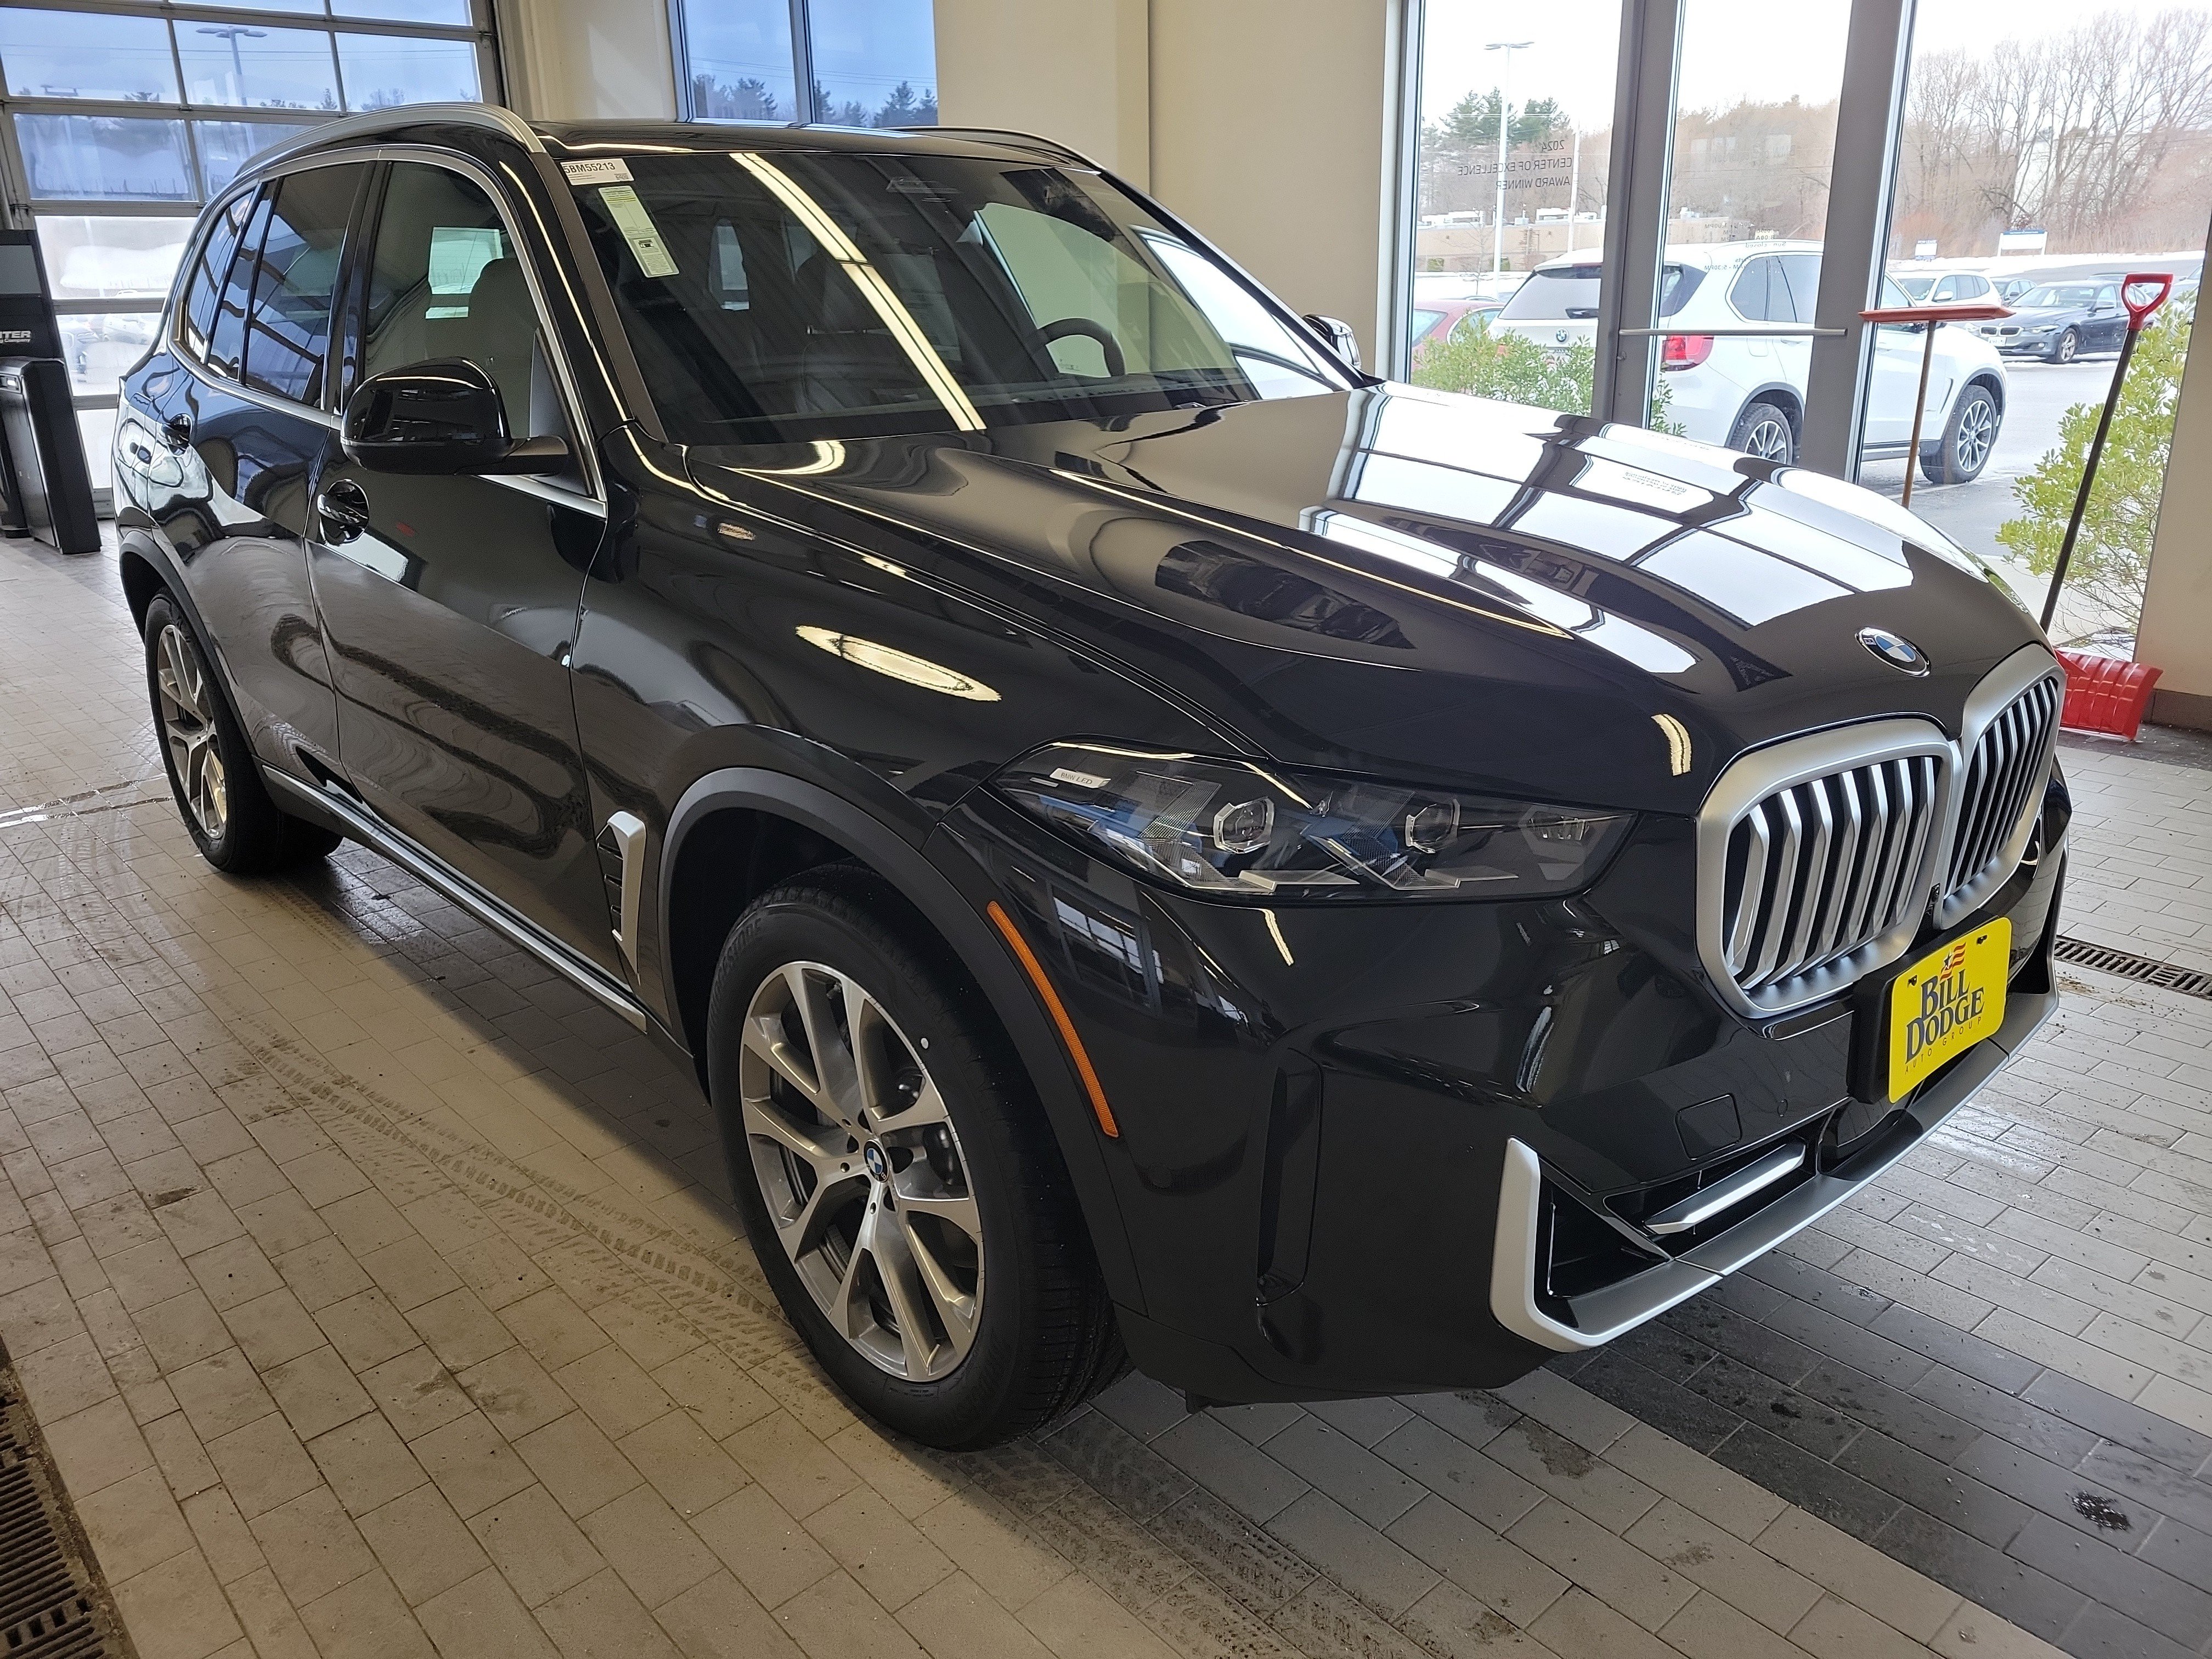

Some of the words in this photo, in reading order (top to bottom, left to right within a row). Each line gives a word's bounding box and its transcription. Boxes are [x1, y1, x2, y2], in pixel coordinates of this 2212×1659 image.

[1076, 776, 1092, 785] LED
[1921, 968, 1971, 1019] BILL
[1905, 987, 1985, 1065] DODGE
[1905, 1048, 1932, 1075] AUTO
[1943, 1016, 1982, 1046] GROUP
